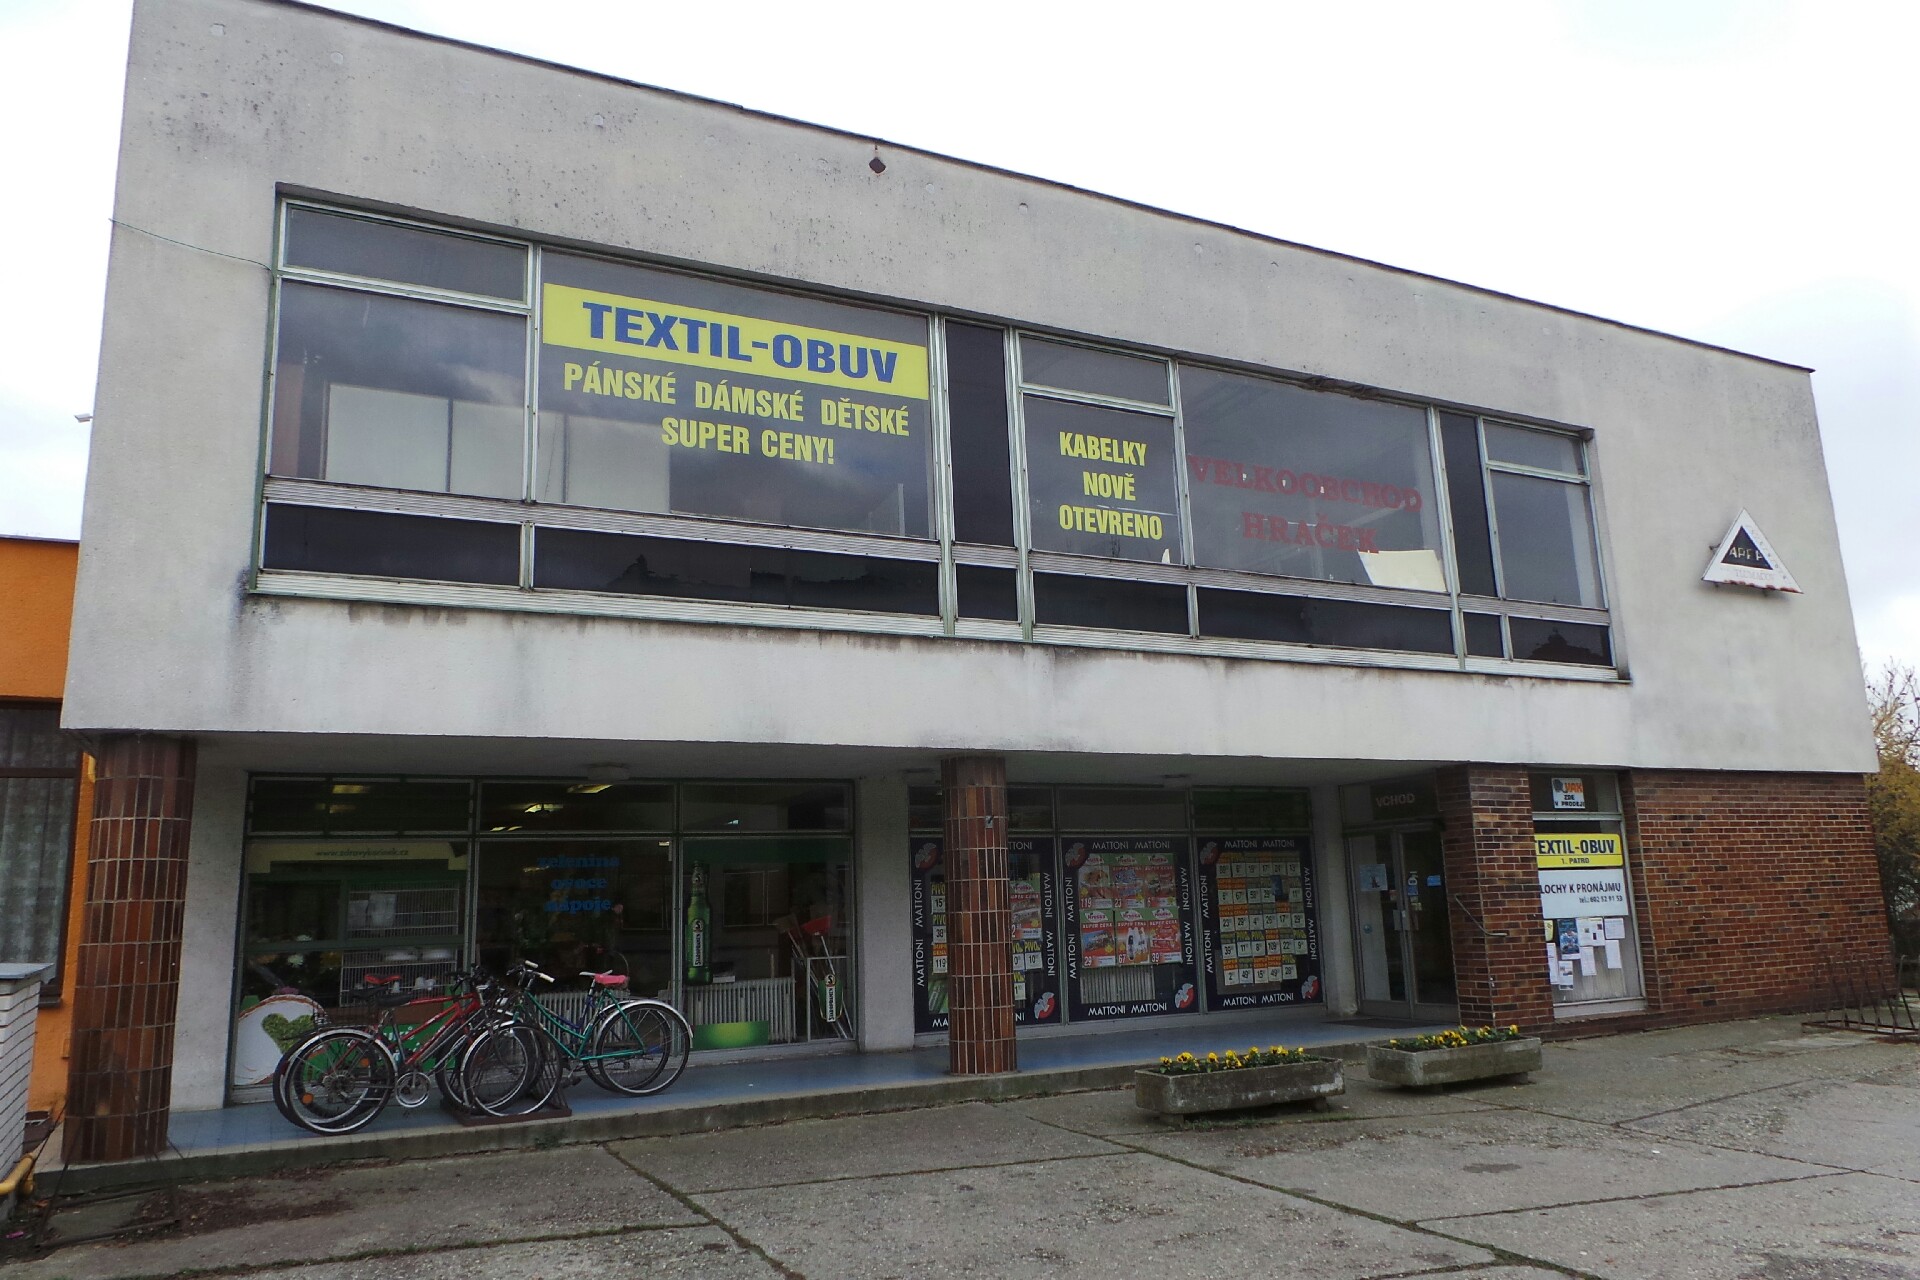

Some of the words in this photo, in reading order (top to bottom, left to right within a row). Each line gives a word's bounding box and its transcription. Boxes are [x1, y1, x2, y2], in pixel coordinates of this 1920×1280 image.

[582, 301, 897, 384] TEXTIL-OBUV
[564, 360, 676, 405] PÁNSKÉ
[695, 379, 804, 423] DÁMSKÉ
[821, 397, 910, 437] DĚTSKÉ
[661, 417, 750, 455] SUPER
[761, 429, 834, 465] CENY!
[1060, 431, 1147, 467] KABELKY
[1083, 471, 1136, 501] NOVĚ
[1186, 453, 1423, 513] VELKOOBCHOD
[1059, 504, 1163, 540] OTEVRENO
[1241, 511, 1380, 554] HRAČEK
[1376, 793, 1416, 808] VCHOD
[1008, 841, 1033, 850] TTONI
[1092, 841, 1129, 850] MATTONI
[1135, 841, 1170, 849] MATTONI
[1224, 840, 1258, 849] MATTONI
[1262, 839, 1295, 848] MATTONI
[1536, 839, 1615, 855] EXTIL-OBUV
[914, 879, 923, 928] MATTONI
[1043, 873, 1053, 918] MATTONI
[1065, 877, 1075, 922] MATTONI
[1180, 867, 1190, 911] MATTONI
[1200, 876, 1210, 919] MATTONI
[1304, 867, 1313, 908] MATTONI
[1540, 884, 1567, 894] LOCHY
[1569, 884, 1576, 894] K
[1576, 881, 1621, 894] PRONÁJMU
[1046, 930, 1055, 977] MATTONI
[1068, 933, 1077, 979] MATTONI
[1184, 921, 1193, 965] MATTONI
[1203, 930, 1214, 974] MATTONI
[1307, 919, 1317, 960] MATTONI
[916, 939, 925, 987] MATTONI
[1088, 1004, 1126, 1016] MATTONI
[1131, 1002, 1167, 1014] MATTONI
[1223, 996, 1257, 1007] MATTONI
[1261, 992, 1294, 1003] MATTONI
